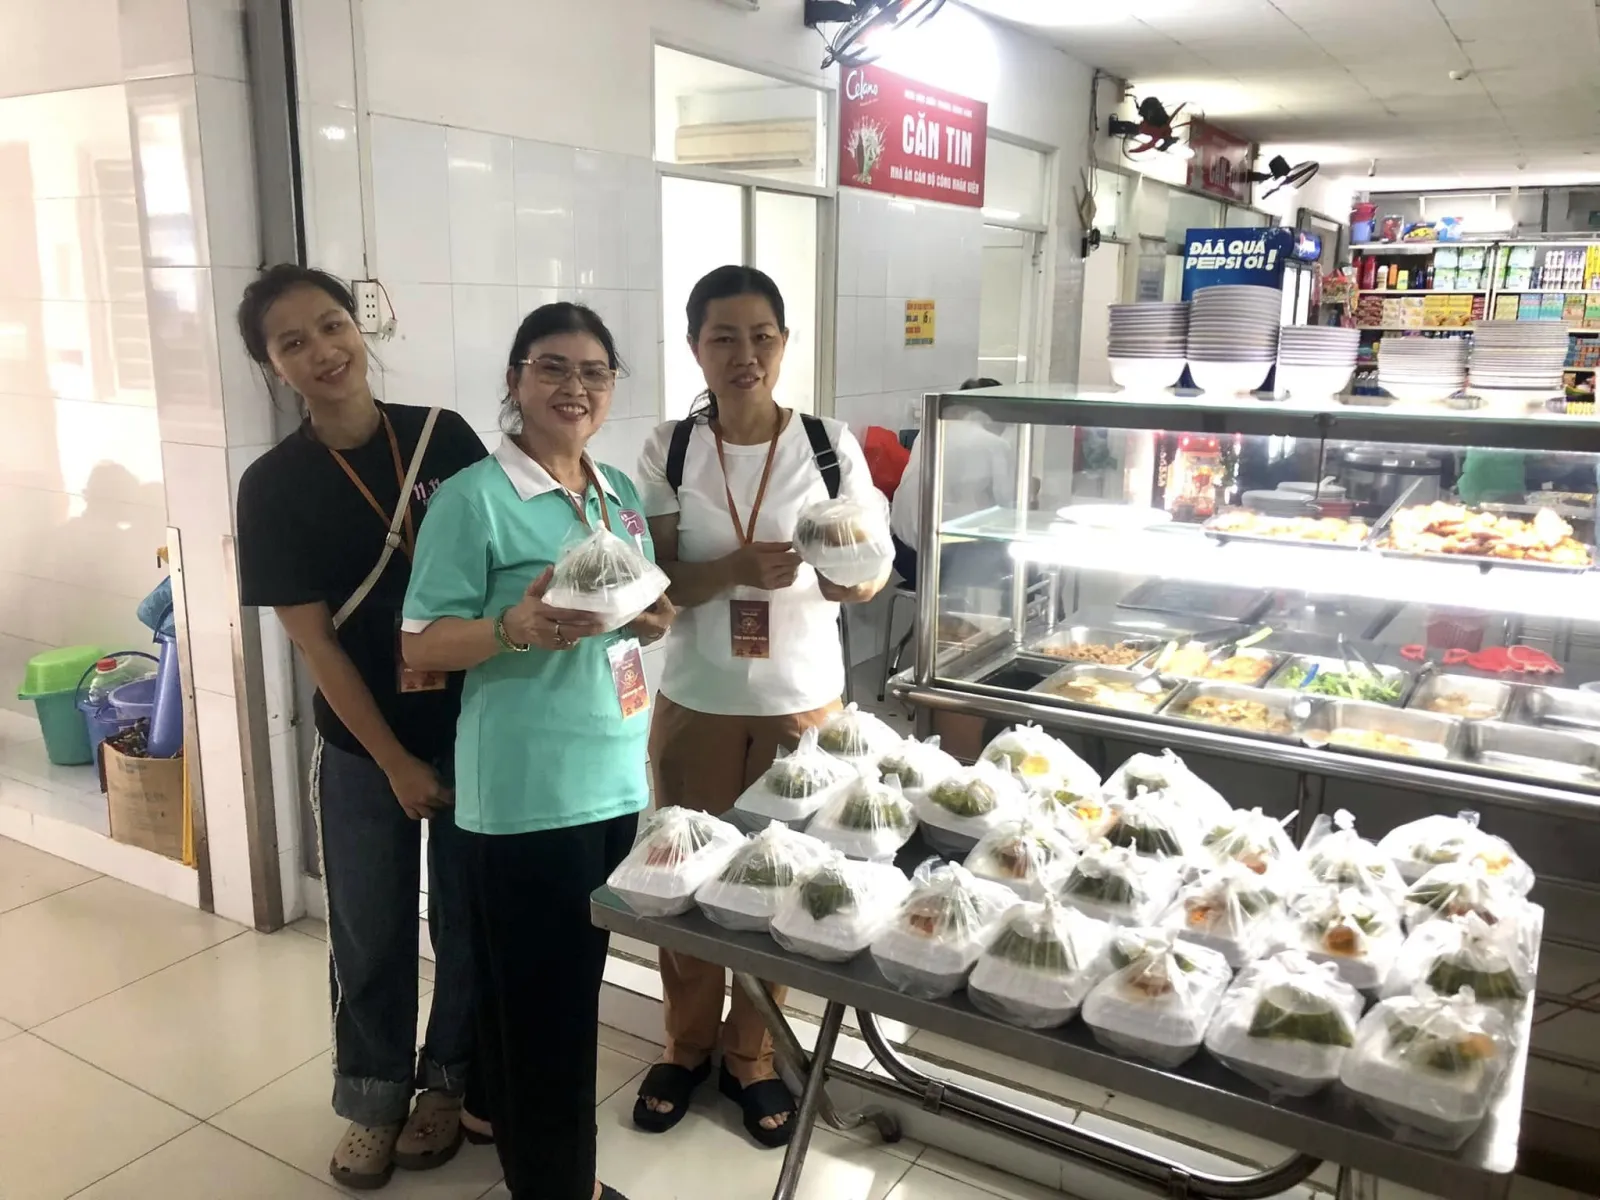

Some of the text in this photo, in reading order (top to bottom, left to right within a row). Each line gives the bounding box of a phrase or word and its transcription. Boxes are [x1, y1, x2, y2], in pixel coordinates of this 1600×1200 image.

[846, 69, 879, 100] Celano
[902, 110, 973, 168] CĂN TIN
[1185, 256, 1242, 270] PEPSI
